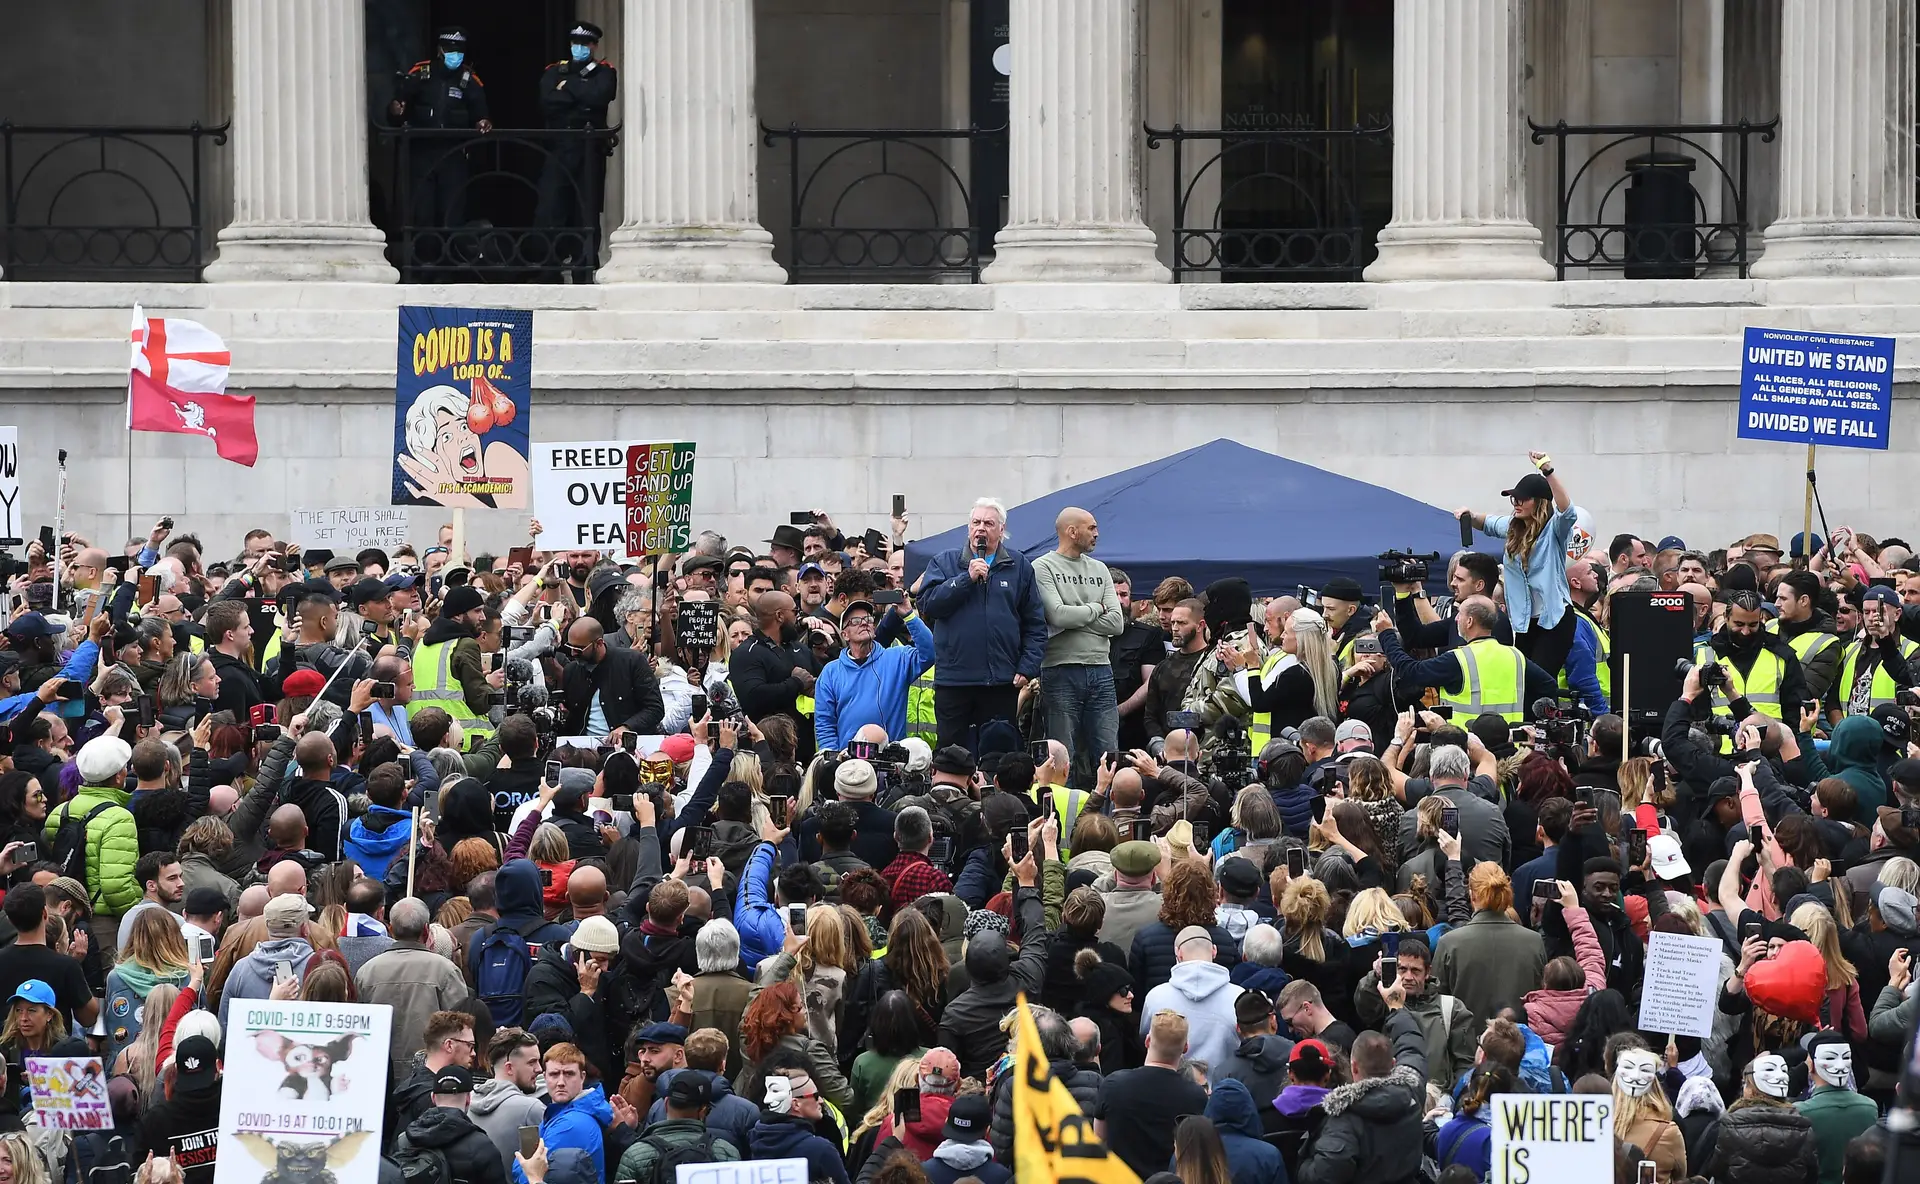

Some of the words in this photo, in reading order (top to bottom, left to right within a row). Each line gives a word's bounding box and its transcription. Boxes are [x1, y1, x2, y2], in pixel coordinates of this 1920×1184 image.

[1225, 113, 1315, 126] NATIONAL
[1764, 332, 1808, 342] NONVIOLENT
[1810, 336, 1828, 344] CIVIL
[1830, 338, 1874, 347] RESISTANCE
[413, 326, 472, 376] COVID
[477, 328, 495, 361] IS
[500, 332, 512, 362] A
[1748, 347, 1804, 367] UNITED
[1808, 352, 1832, 369] WE
[1836, 354, 1888, 373] STAND
[453, 364, 484, 380] LOAD
[488, 364, 512, 380] OF...
[1754, 374, 1771, 382] ALL
[1774, 375, 1806, 386] RACES,
[1808, 378, 1825, 387] ALL
[1828, 380, 1880, 392] RELIGIONS,
[1759, 384, 1776, 393] ALL
[1779, 386, 1824, 397] GENDERS,
[1826, 390, 1844, 398] ALL
[1846, 391, 1874, 401] AGES,
[1752, 393, 1769, 402] ALL
[1771, 395, 1807, 405] SHAPES
[1809, 398, 1828, 406] AND
[1831, 400, 1848, 408] ALL
[1851, 401, 1880, 410] SIZES.
[1749, 412, 1809, 432] DIVIDED
[1813, 417, 1836, 435] WE
[1840, 419, 1877, 438] FALL
[552, 448, 628, 467] FREED
[635, 449, 670, 472] GET
[671, 451, 695, 470] UP
[438, 483, 454, 493] IT'S
[454, 483, 462, 493] A
[462, 483, 513, 494] SCAMDEMIC!
[626, 473, 670, 493] STAND
[673, 473, 693, 491] UP
[567, 482, 626, 506] OVE
[634, 493, 660, 504] STAND
[666, 493, 678, 501] UP
[331, 510, 370, 524] TRUTH
[375, 510, 407, 521] SHALL
[627, 505, 652, 525] FOR
[656, 504, 690, 524] YOUR
[314, 528, 336, 540] SET
[577, 523, 626, 545] FEA
[630, 525, 689, 552] RIGHTS
[358, 539, 380, 547] JOHN
[1055, 573, 1103, 587] Firetrap
[1650, 598, 1683, 606] 2000
[689, 616, 716, 625] PEOPLE!
[1686, 944, 1712, 952] Distancing
[1658, 954, 1684, 962] Mandatory
[1652, 993, 1687, 1001] entertainment
[1654, 986, 1687, 995] Brainwashing
[307, 1013, 322, 1028] AT
[325, 1014, 371, 1030] 9:59PM
[293, 1115, 307, 1129] AT
[312, 1116, 342, 1130] 10:01
[346, 1118, 363, 1131] PM
[1502, 1100, 1609, 1142] WHERE?
[181, 1135, 204, 1151] JOIN
